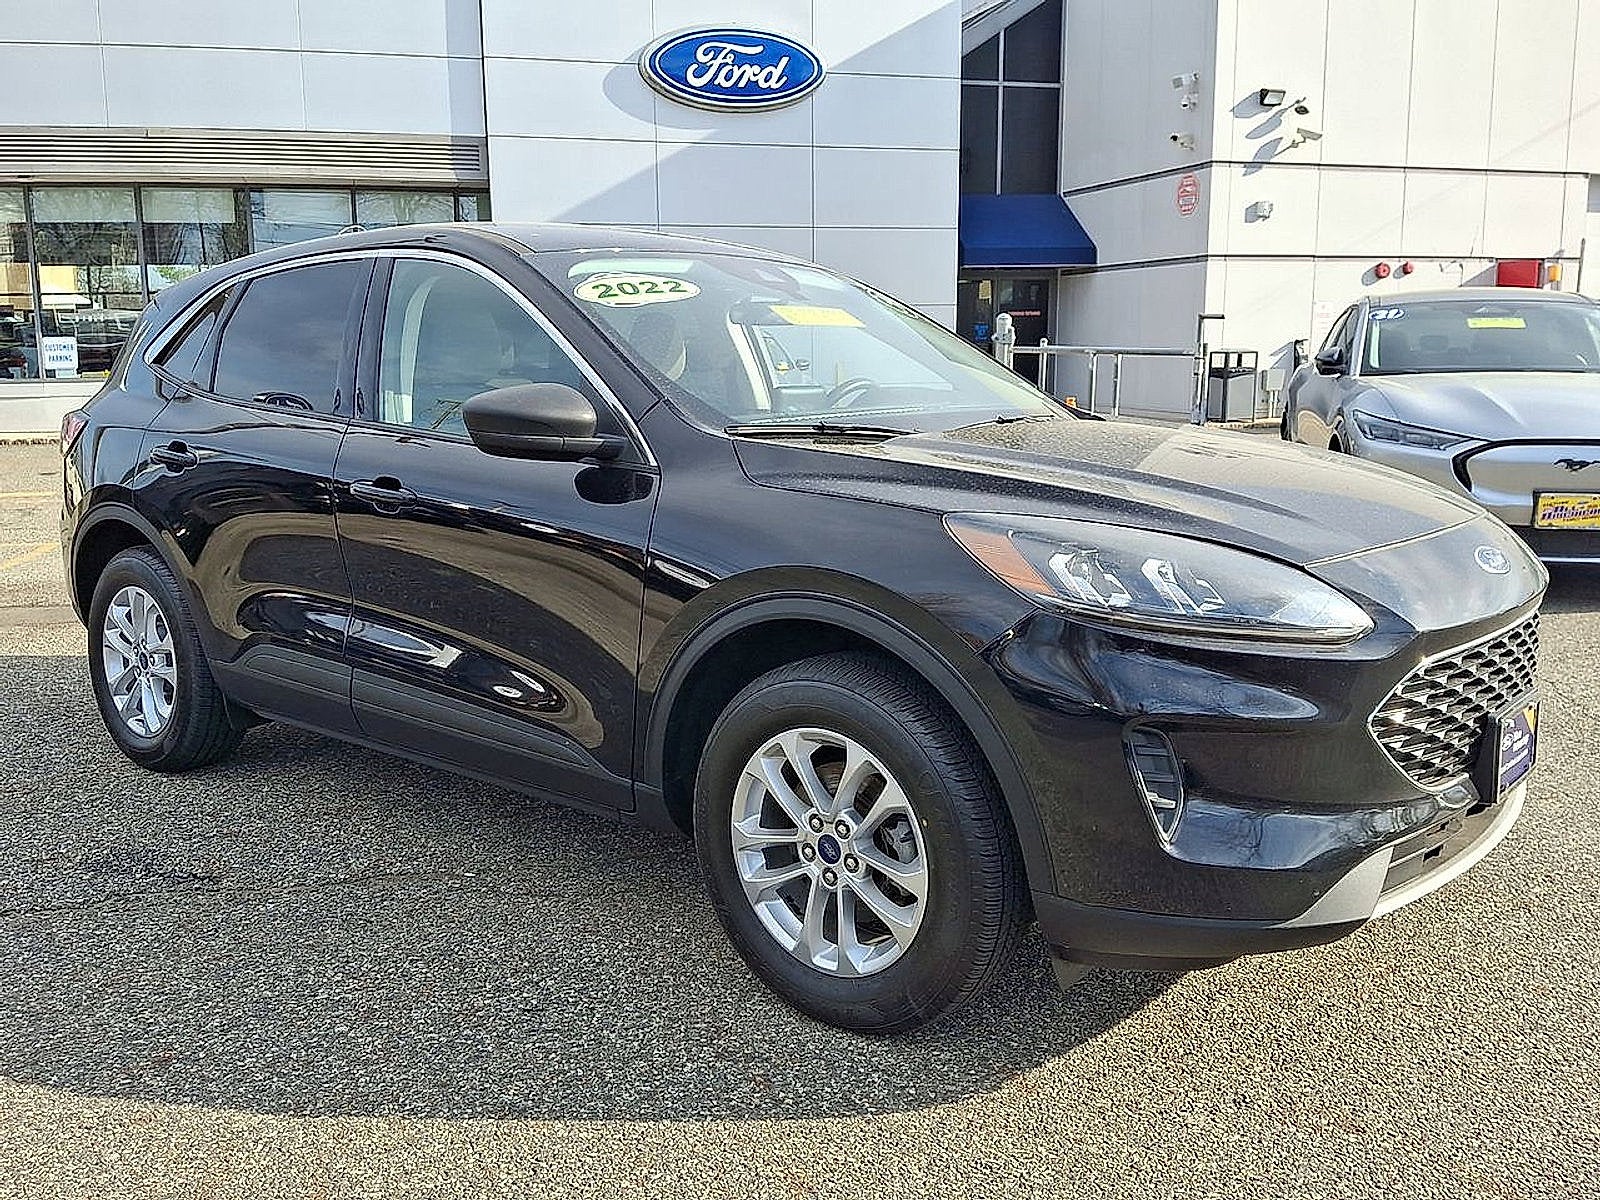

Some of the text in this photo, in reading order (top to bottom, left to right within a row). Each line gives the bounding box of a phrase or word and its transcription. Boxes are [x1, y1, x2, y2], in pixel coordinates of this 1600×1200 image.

[686, 42, 790, 88] Ford
[592, 281, 687, 299] 2022
[45, 344, 75, 352] CUSTOMER
[48, 354, 73, 362] PARKING
